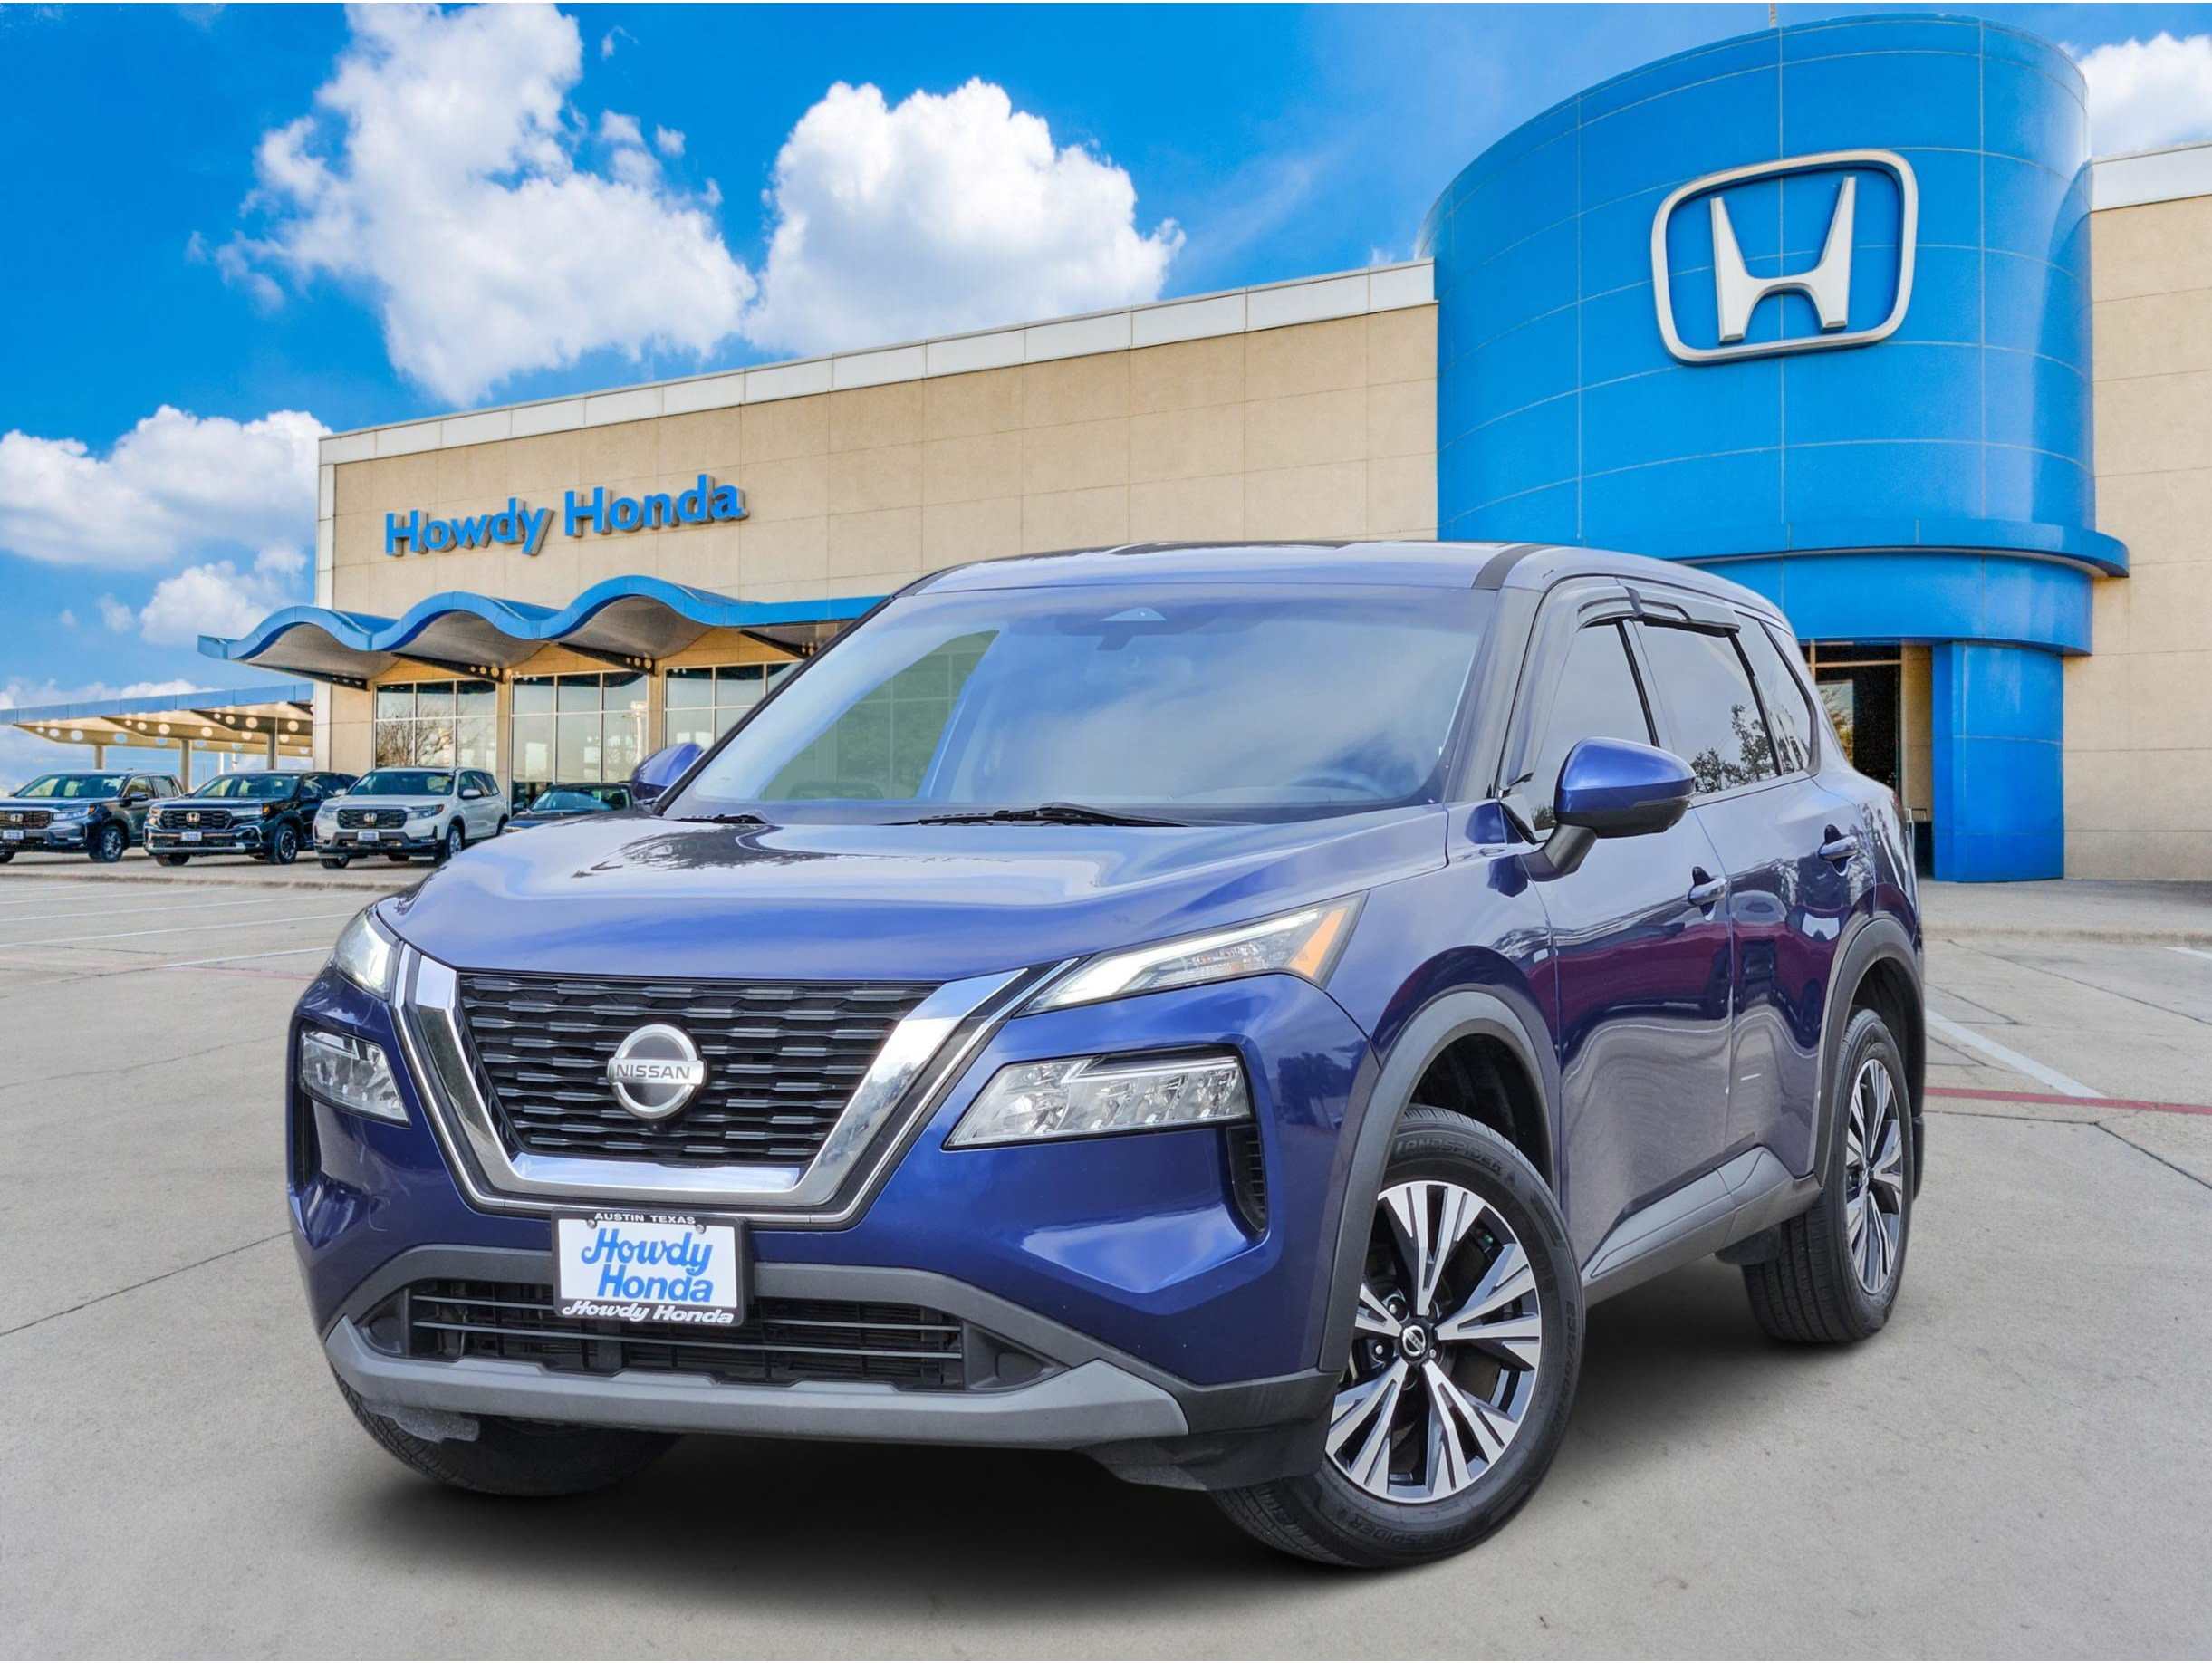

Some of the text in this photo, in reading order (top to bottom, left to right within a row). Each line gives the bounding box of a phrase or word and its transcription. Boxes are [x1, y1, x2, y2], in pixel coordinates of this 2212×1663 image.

[385, 474, 748, 556] Howdy Honda
[616, 1064, 690, 1079] NISSAN
[594, 1212, 696, 1225] AUSTIN TEXAS
[581, 1227, 713, 1276] Howdy
[597, 1264, 714, 1303] Honda
[562, 1300, 734, 1324] Howdy Honda
